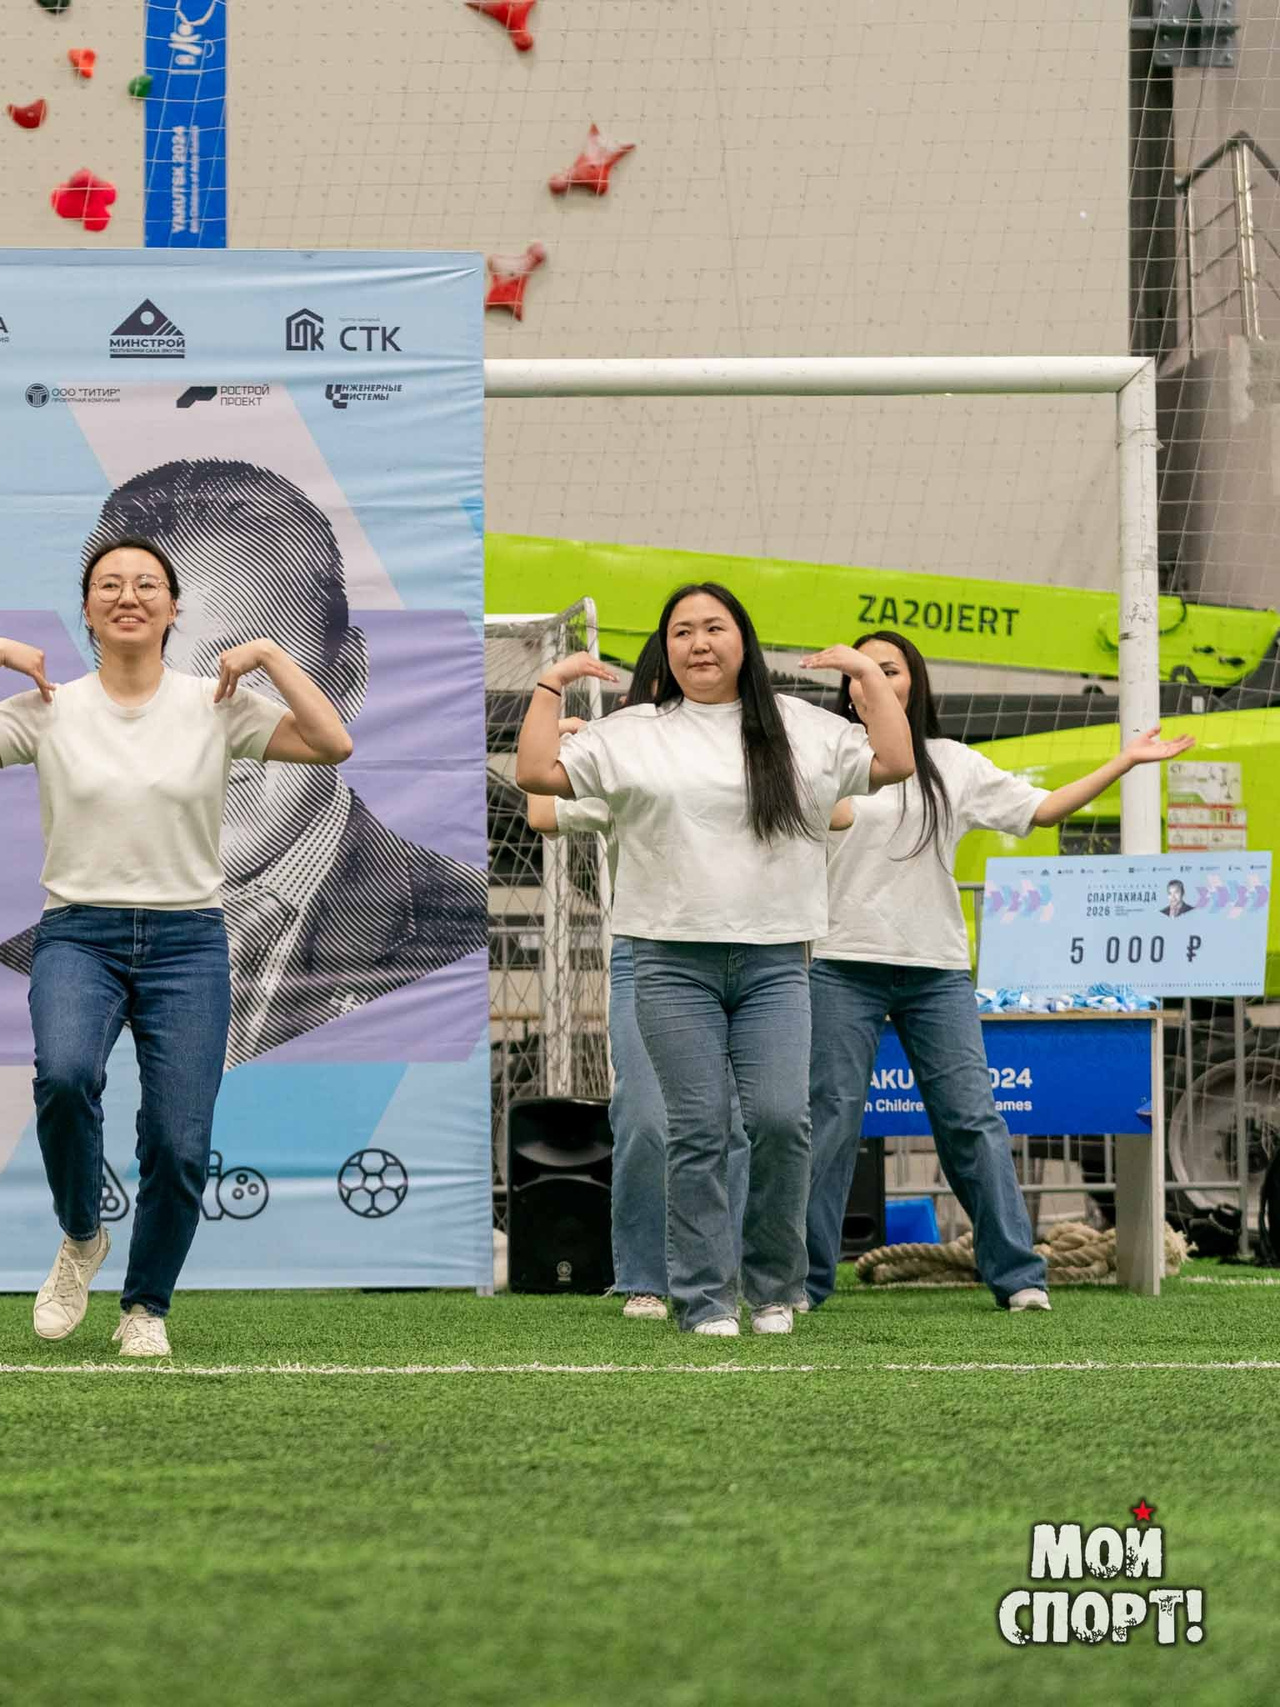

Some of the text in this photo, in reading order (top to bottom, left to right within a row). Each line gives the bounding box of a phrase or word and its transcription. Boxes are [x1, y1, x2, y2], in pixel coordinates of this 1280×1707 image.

[172, 126, 186, 233] YAKUTSK 2024
[109, 337, 186, 348] МИНСТРОЙ
[339, 326, 402, 352] СТК
[51, 388, 76, 397] ООО
[220, 383, 270, 395] РОСТРОЙ
[220, 397, 262, 406] ПРОЕКТ
[857, 593, 1020, 637] ZA20JERT
[1087, 891, 1157, 903] СПАРТАКИАДА
[1086, 906, 1111, 917] 2026
[1070, 937, 1085, 964] 5
[1106, 935, 1165, 964] 000
[989, 1067, 1033, 1089] 024
[875, 1099, 926, 1113] Childre
[994, 1100, 1033, 1112] ames
